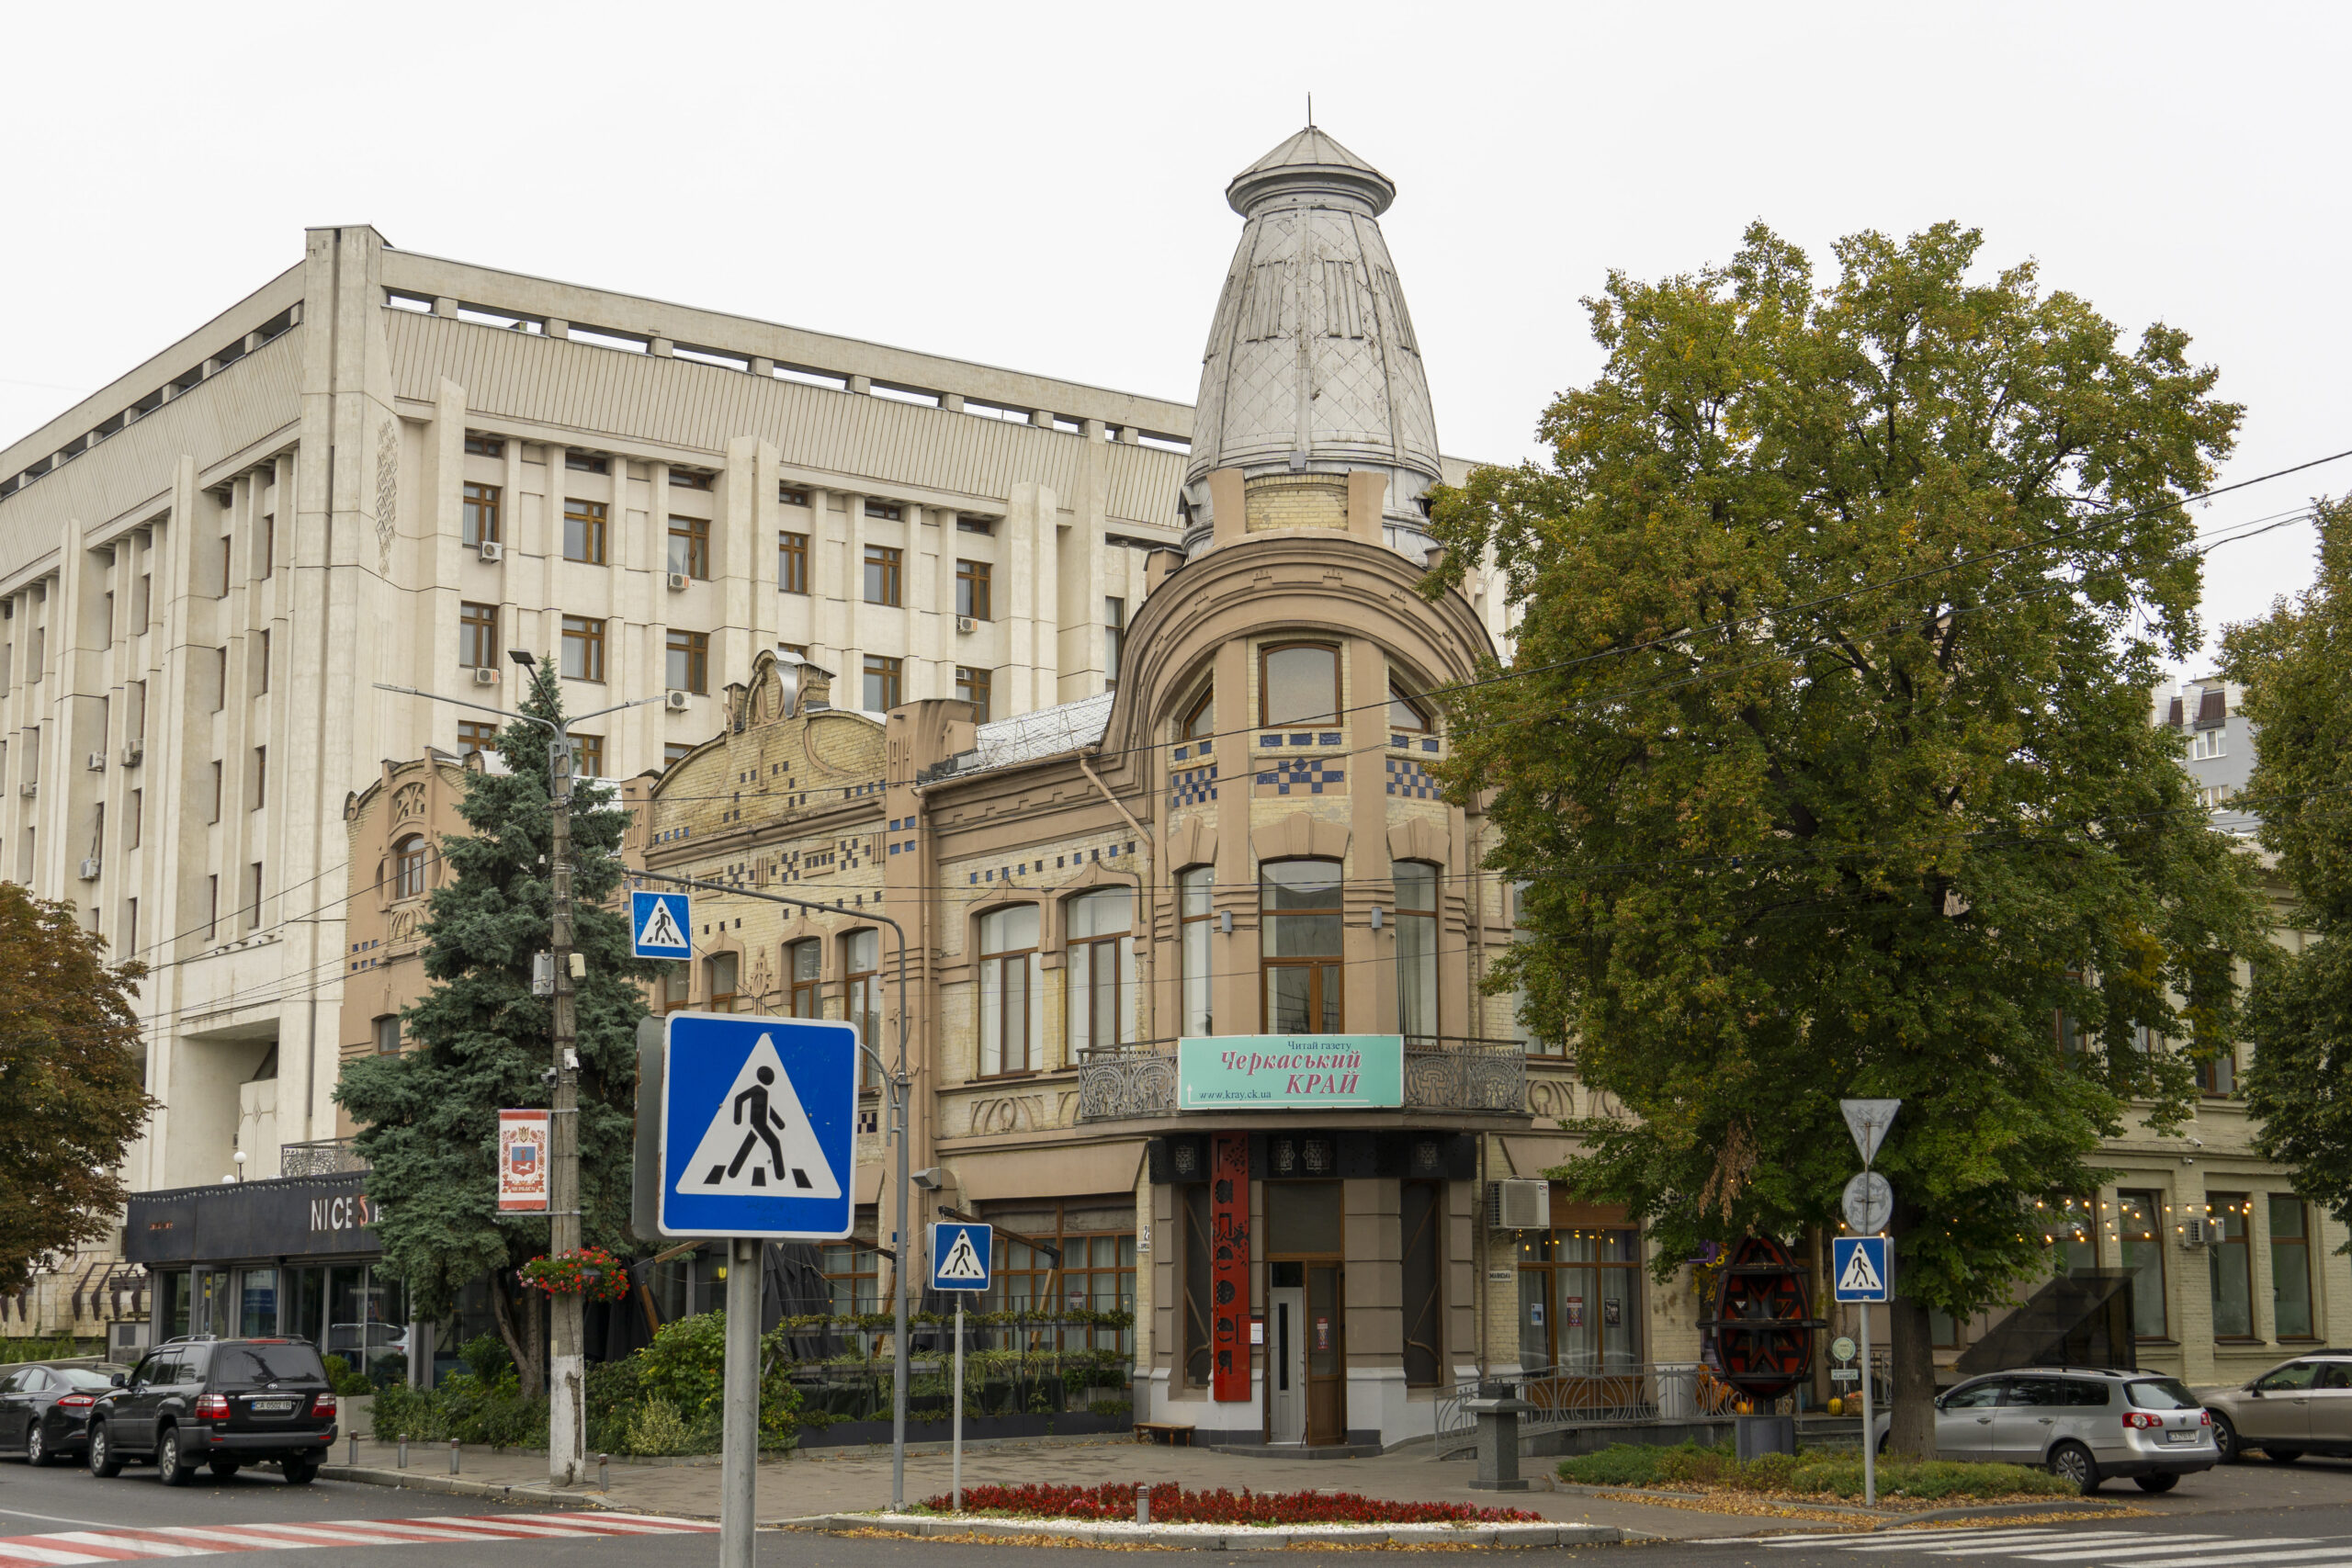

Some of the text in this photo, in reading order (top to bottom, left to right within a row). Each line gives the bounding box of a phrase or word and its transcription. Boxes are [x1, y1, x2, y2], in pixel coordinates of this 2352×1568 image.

[1287, 1040, 1351, 1053] Читай газету
[1221, 1050, 1362, 1077] Черкаський
[1284, 1070, 1361, 1094] КРАЙ
[1198, 1089, 1272, 1100] www.kray.ck.ua
[311, 1196, 353, 1231] NICE
